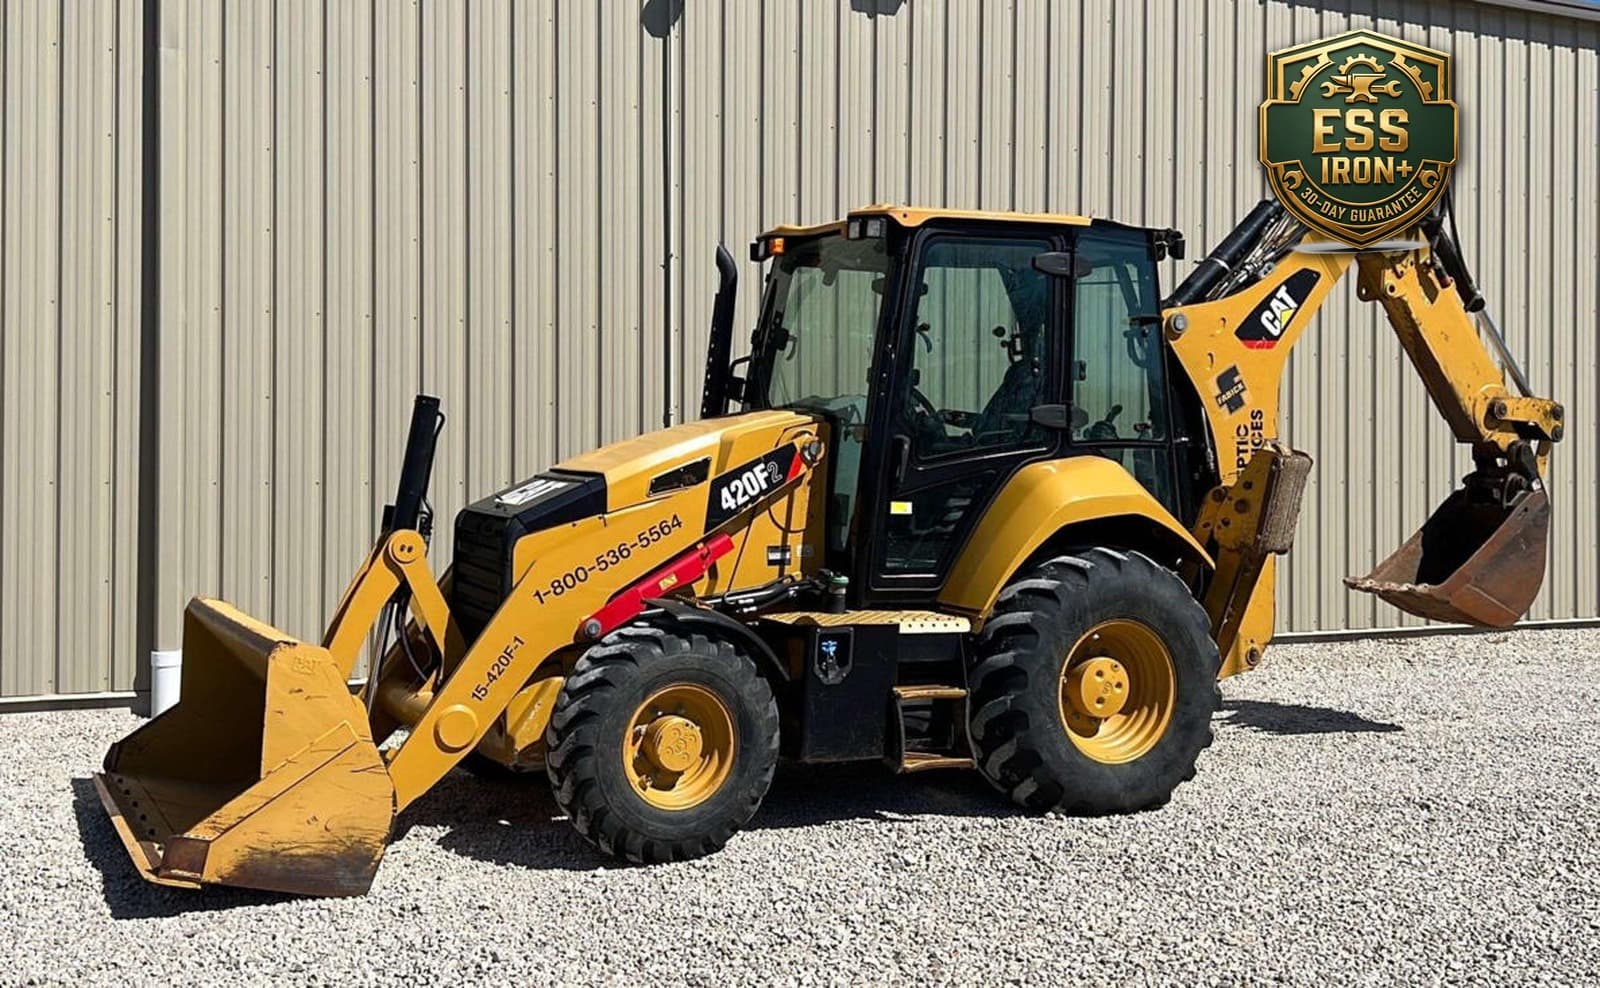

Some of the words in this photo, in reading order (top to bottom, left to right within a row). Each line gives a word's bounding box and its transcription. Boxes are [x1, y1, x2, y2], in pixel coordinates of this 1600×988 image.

[1261, 285, 1298, 337] CAT
[1236, 423, 1249, 472] PTIC
[1250, 409, 1263, 455] ICES
[532, 514, 683, 605] 1-800-536-5564
[471, 635, 525, 701] 15-420F-1
